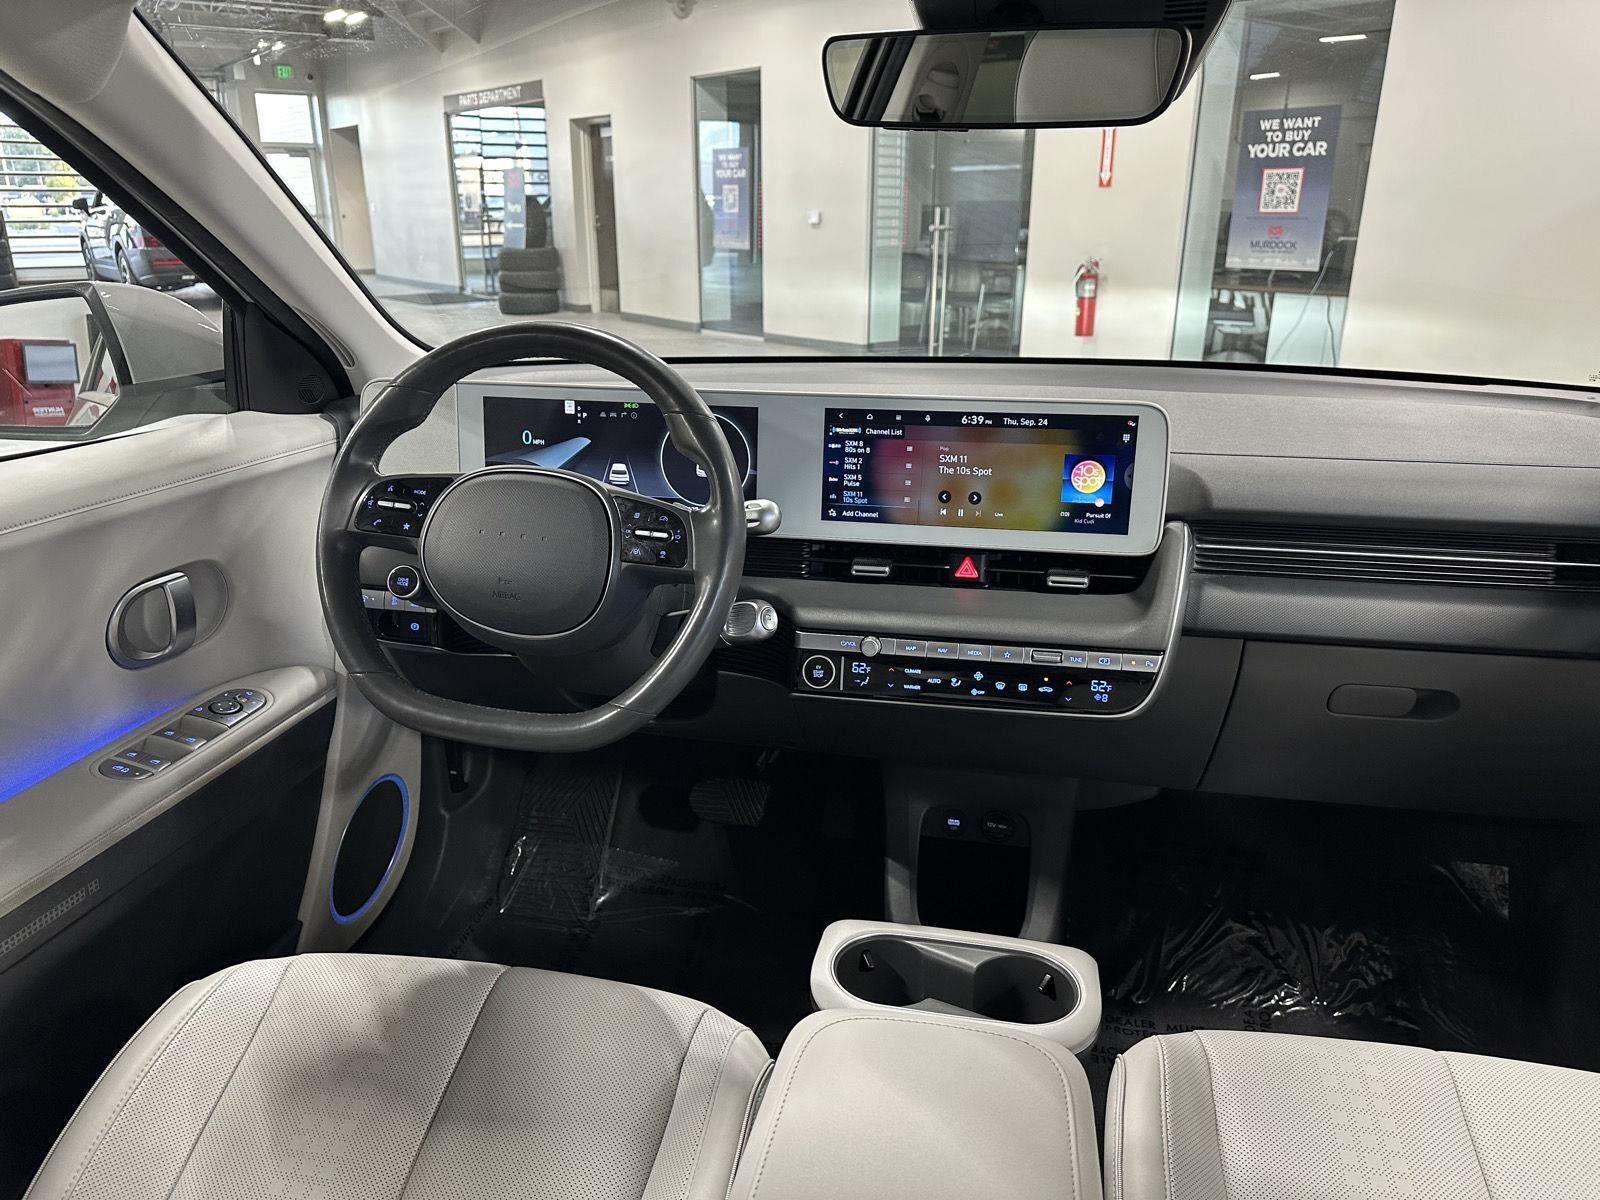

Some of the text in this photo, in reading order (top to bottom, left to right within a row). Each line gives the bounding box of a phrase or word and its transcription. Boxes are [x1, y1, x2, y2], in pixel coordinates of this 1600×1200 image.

[479, 85, 521, 104] DEPARTMENT
[1260, 116, 1322, 130] WE WANT
[1266, 129, 1312, 142] TO BUY
[1248, 141, 1328, 158] YOUR CAR
[961, 415, 984, 425] 6:39
[1003, 417, 1019, 426] Thu,
[1020, 418, 1036, 427] Sep.
[522, 430, 545, 446] 0 MPH
[939, 454, 968, 463] SXM 11
[939, 466, 993, 477] The 10s Spot
[491, 590, 521, 601] AIRBAG
[1105, 1014, 1156, 1030] DEALER
